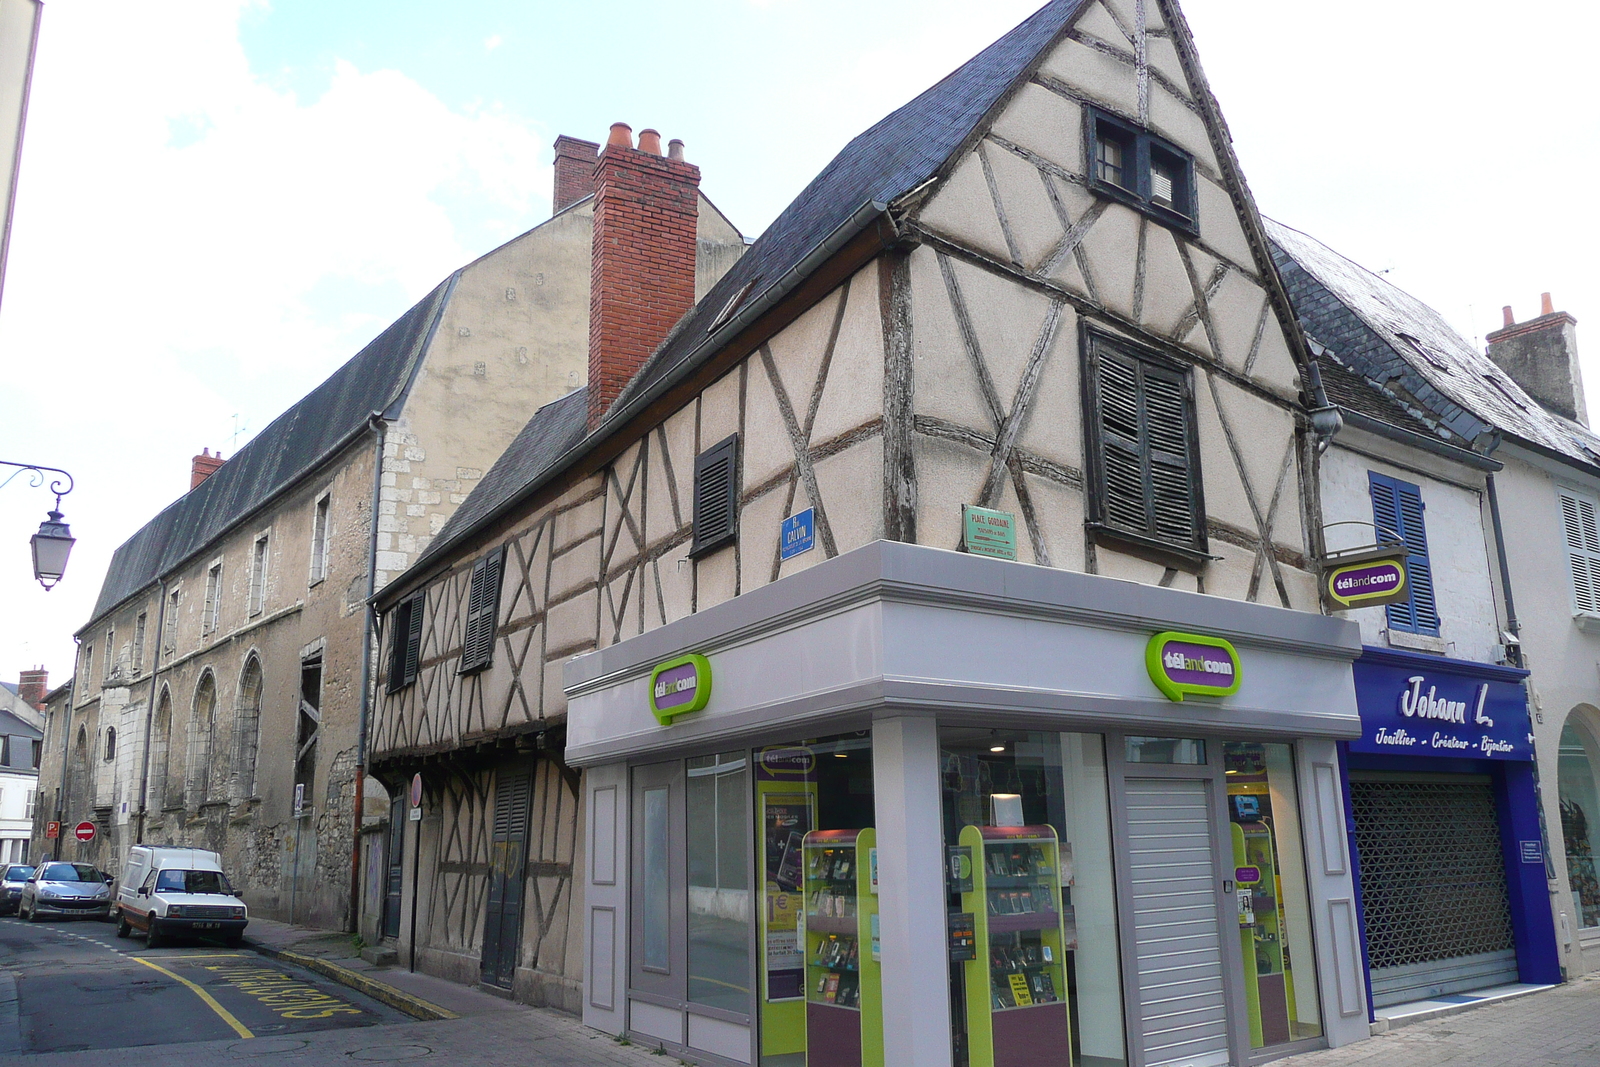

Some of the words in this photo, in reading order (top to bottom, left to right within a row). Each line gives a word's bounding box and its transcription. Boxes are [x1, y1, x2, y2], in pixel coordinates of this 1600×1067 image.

[971, 513, 986, 524] PLACE
[787, 525, 806, 544] CALVIN
[1337, 570, 1396, 590] télandcom
[1164, 651, 1232, 675] télandcom
[654, 676, 696, 698] télandcom
[1402, 675, 1466, 725] Johann
[1375, 727, 1417, 746] Joaillier
[1432, 731, 1469, 749] Créateur
[1481, 735, 1514, 756] Bijoutier
